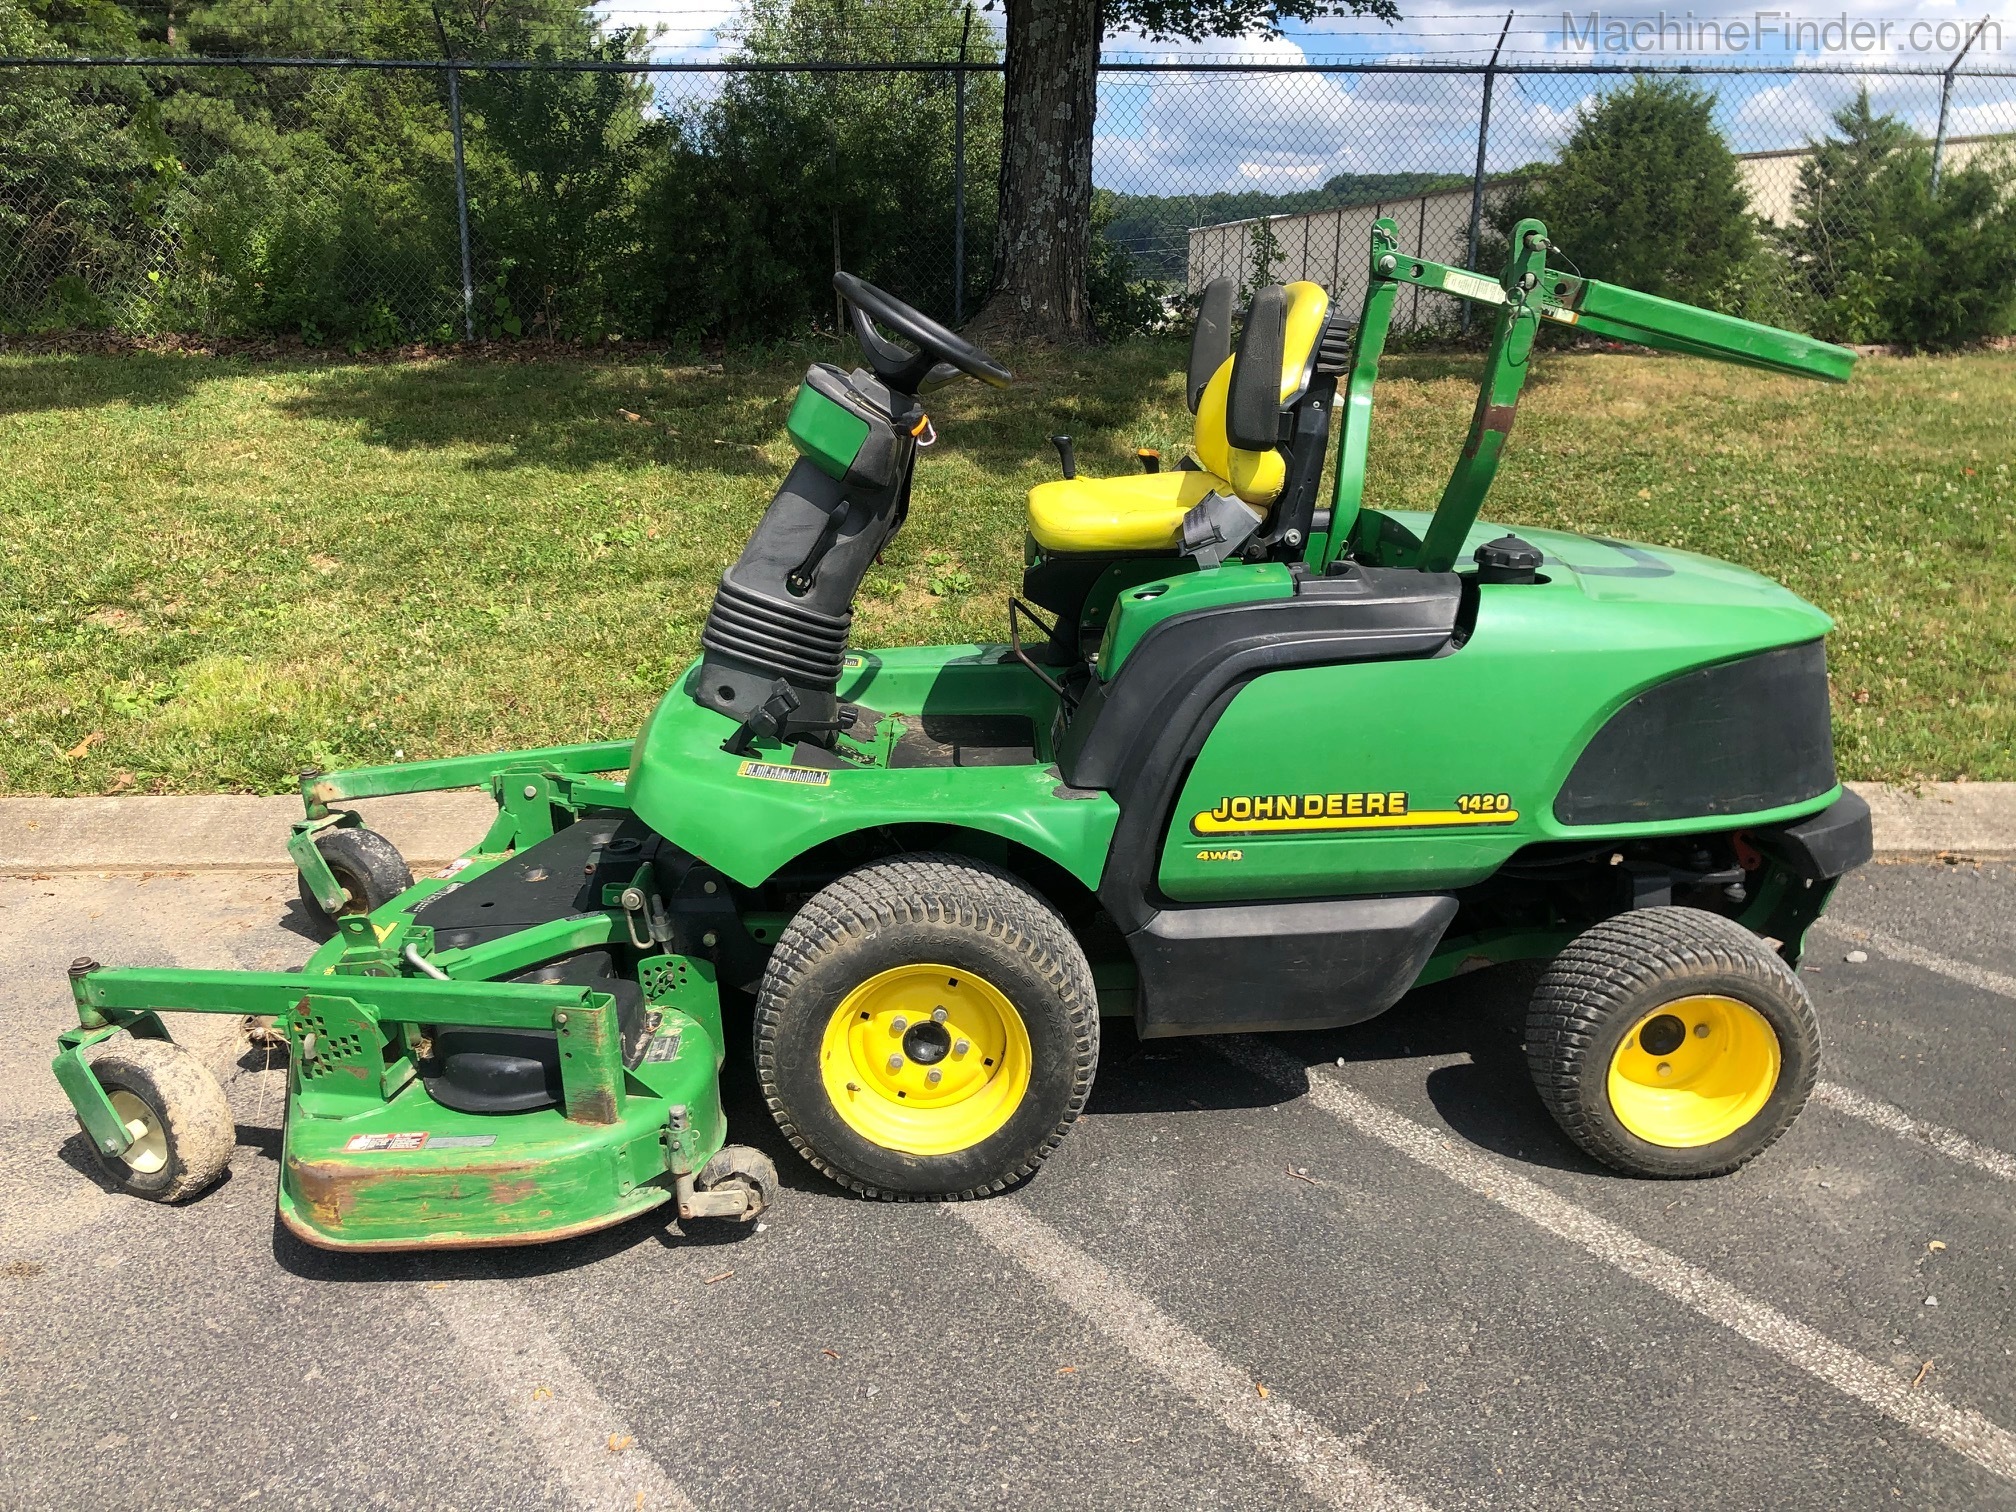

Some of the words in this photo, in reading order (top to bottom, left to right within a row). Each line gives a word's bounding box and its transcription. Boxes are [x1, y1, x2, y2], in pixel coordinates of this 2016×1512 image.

[1212, 795, 1298, 819] JOHN
[1304, 792, 1406, 815] DEERE
[1457, 794, 1509, 811] 1420
[1196, 850, 1243, 861] 4WD
